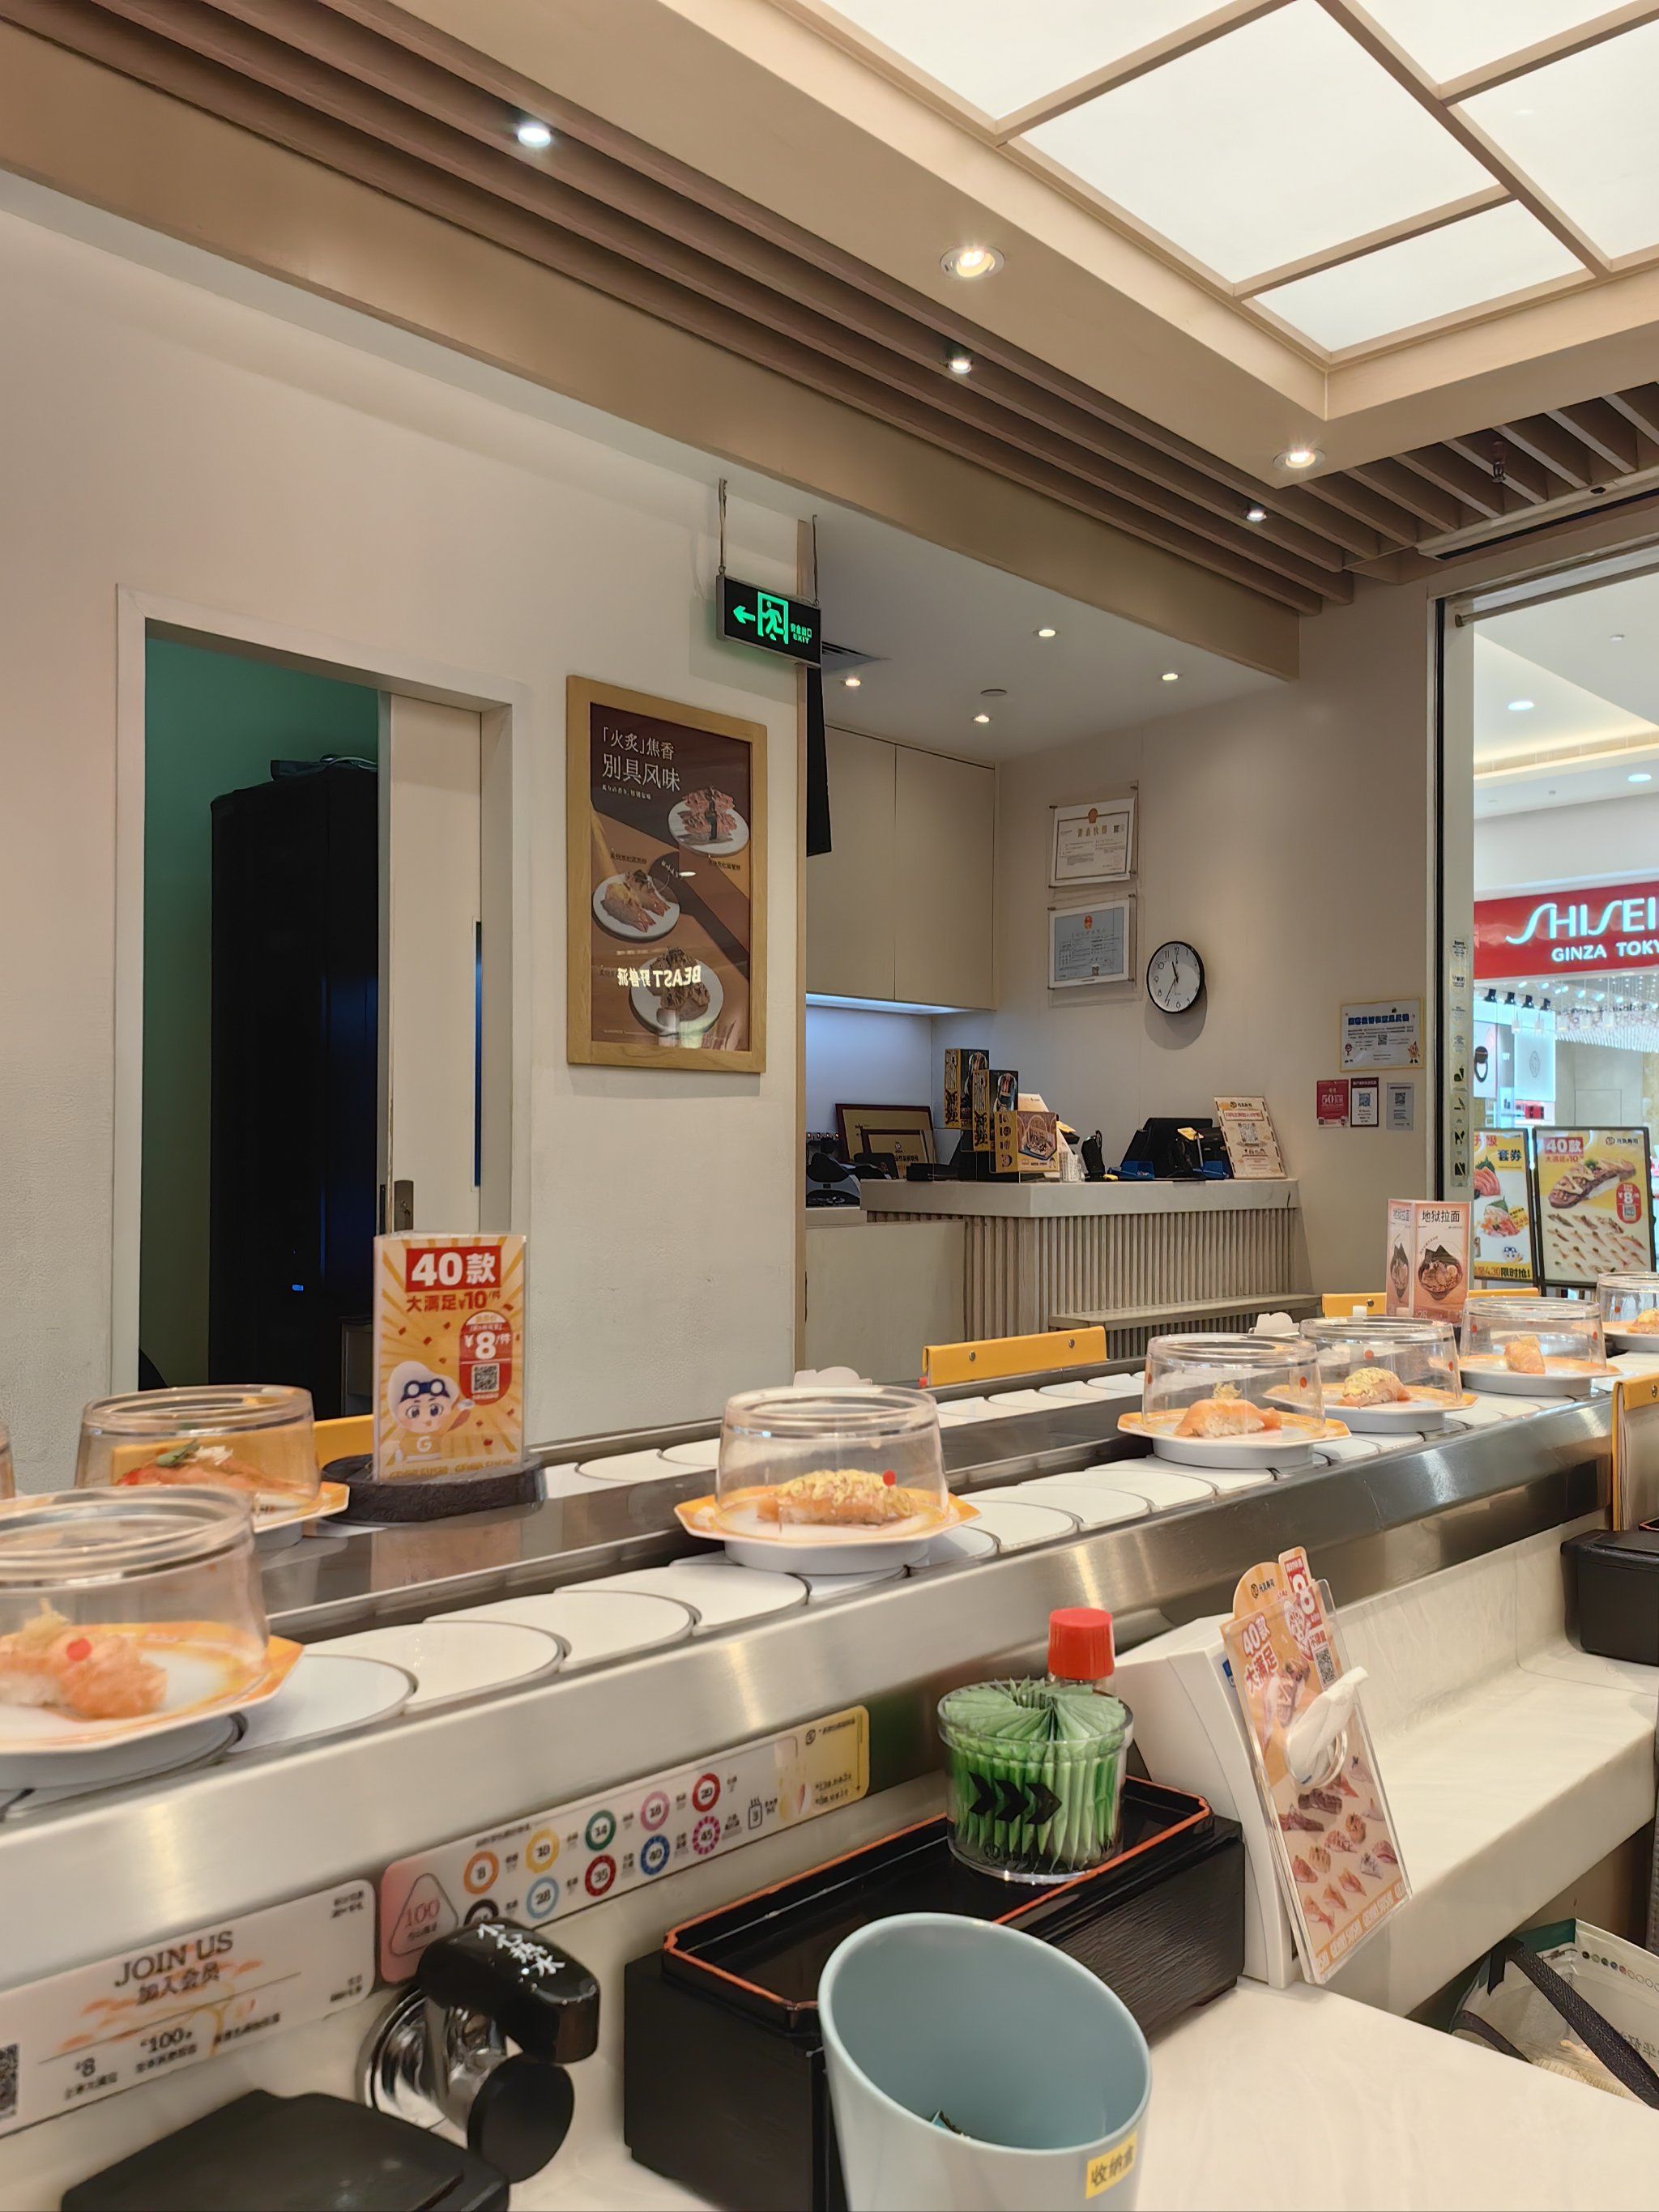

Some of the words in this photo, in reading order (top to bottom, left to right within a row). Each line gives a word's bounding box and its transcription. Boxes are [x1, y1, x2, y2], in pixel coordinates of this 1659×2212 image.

[792, 633, 810, 645] EXIT
[1550, 944, 1608, 962] GINZA
[1545, 1138, 1581, 1153] 40款
[1422, 1209, 1461, 1223] 地狱拉面
[411, 1251, 497, 1287] 40款
[1242, 1612, 1271, 1658] 40款
[406, 1898, 441, 1928] 100
[113, 1943, 189, 1988] JOIN
[195, 1930, 233, 1960] US
[137, 1961, 220, 2006] 加入会员
